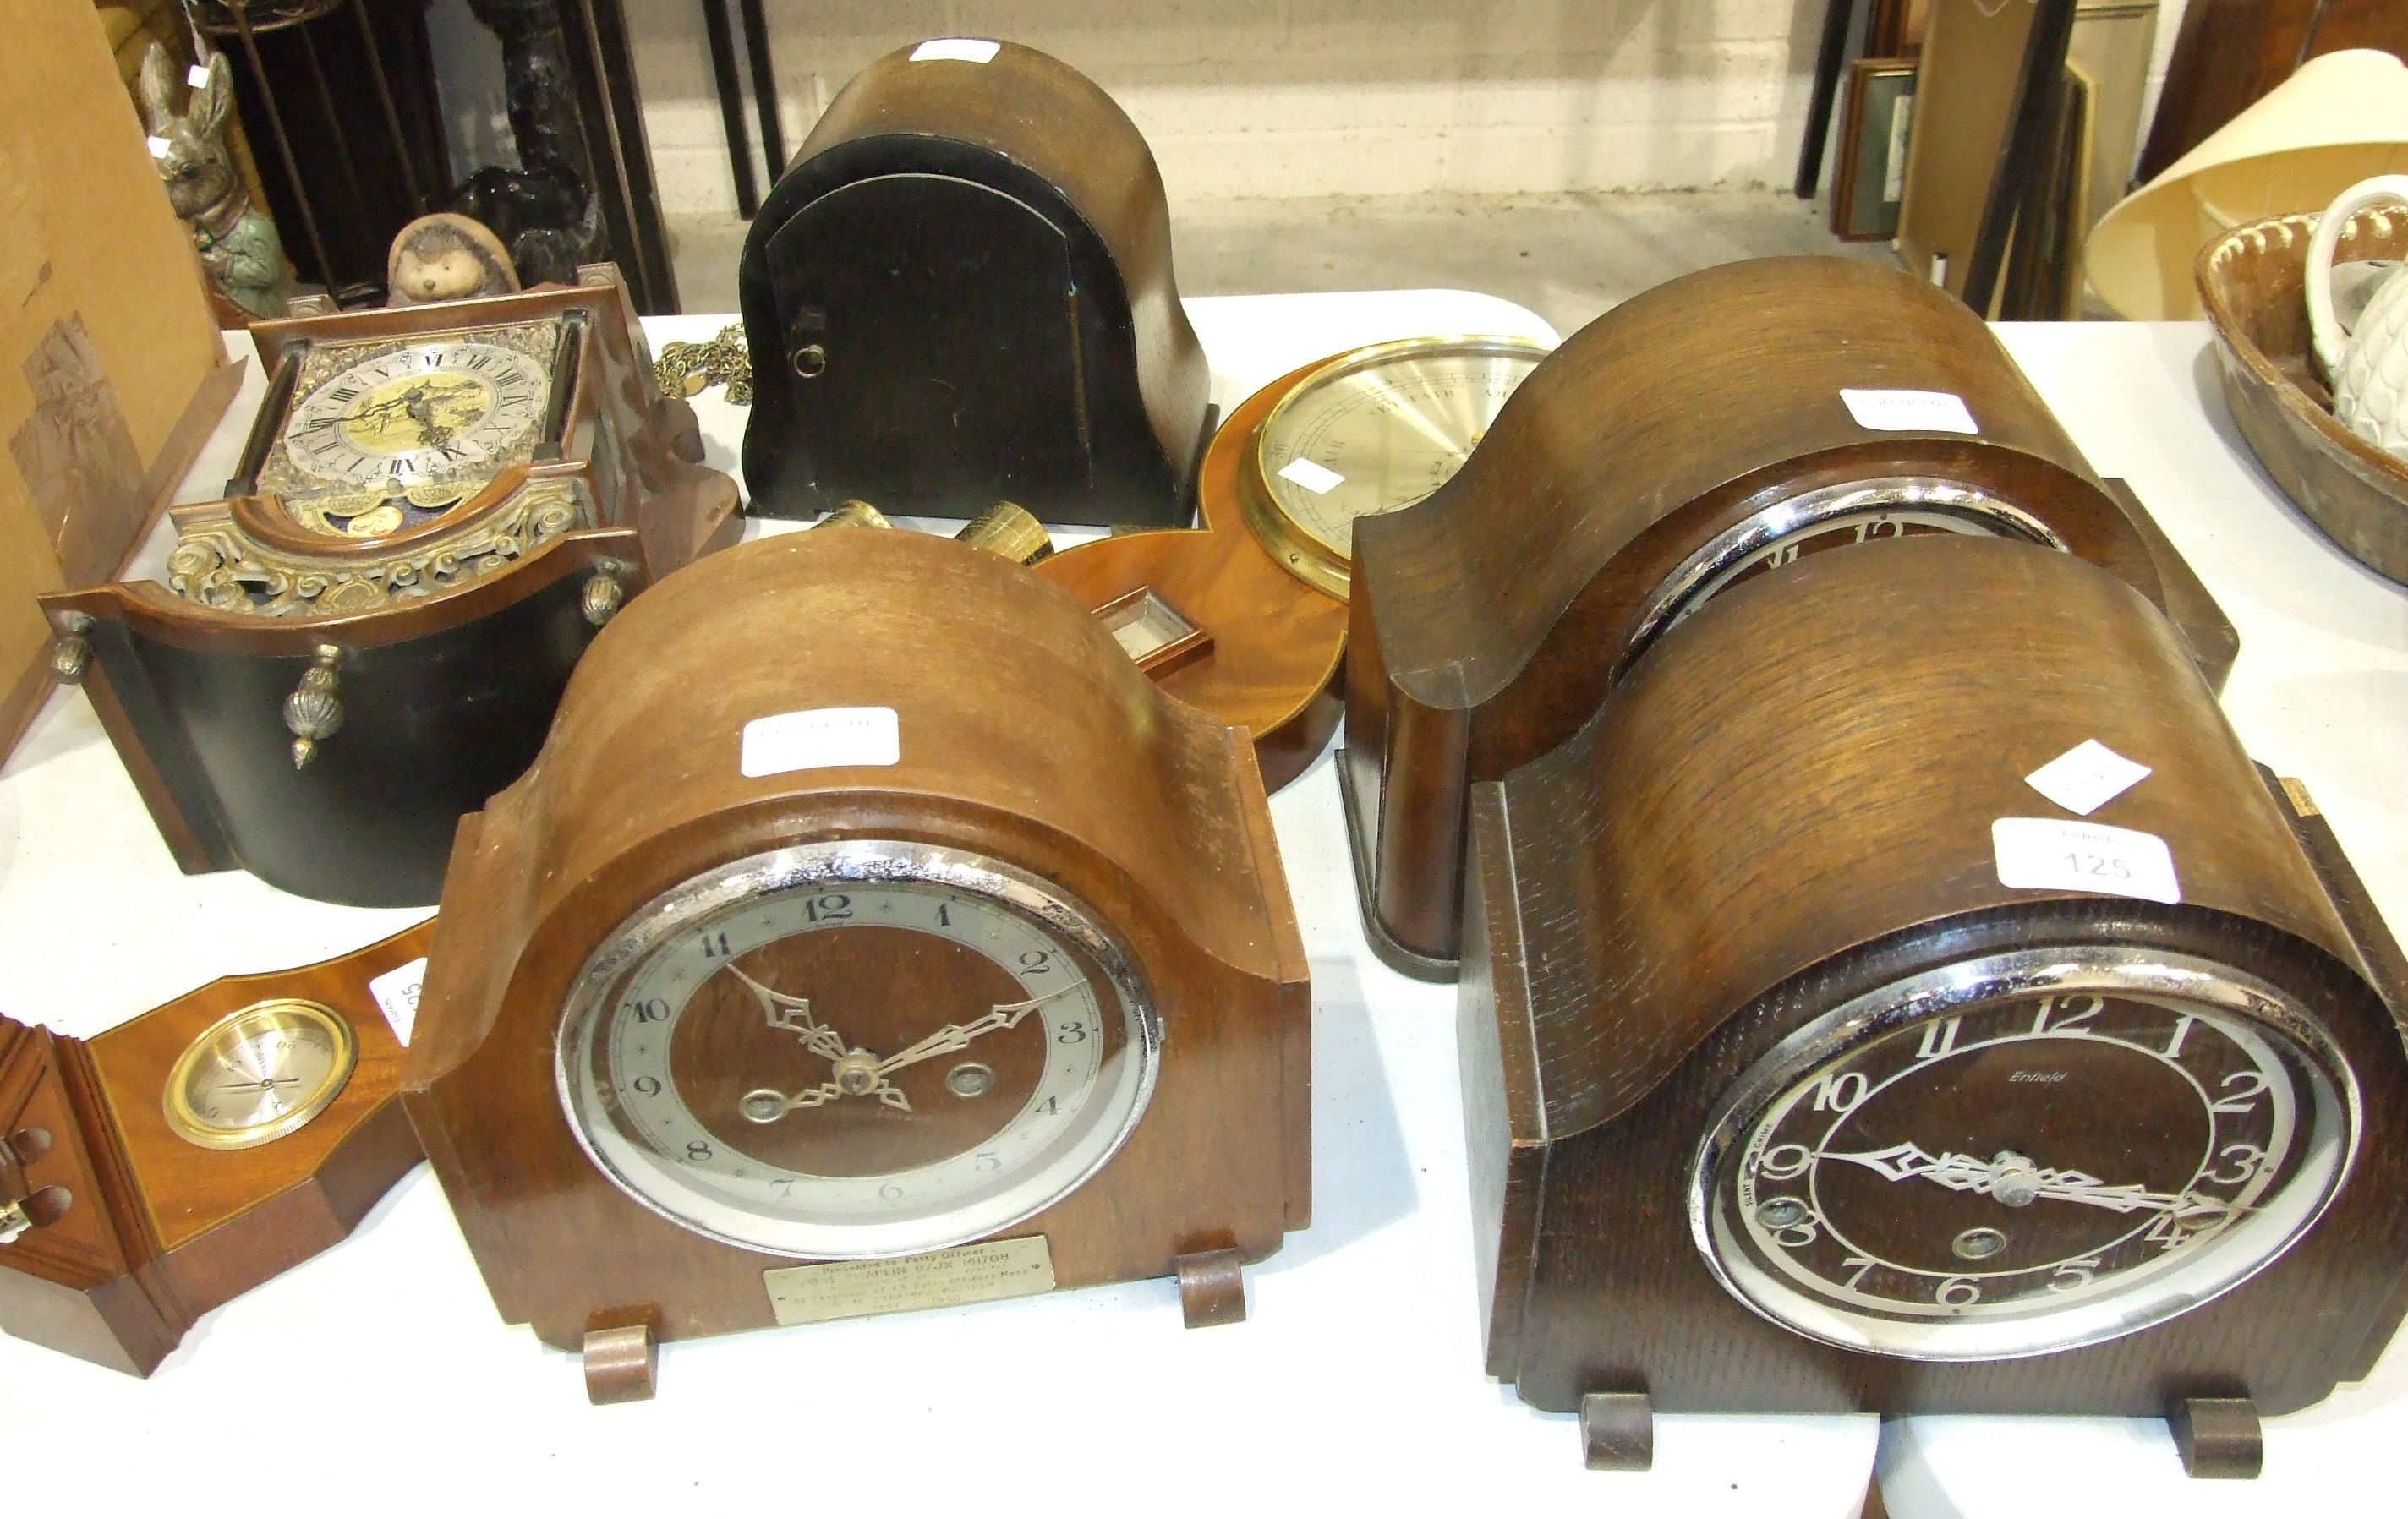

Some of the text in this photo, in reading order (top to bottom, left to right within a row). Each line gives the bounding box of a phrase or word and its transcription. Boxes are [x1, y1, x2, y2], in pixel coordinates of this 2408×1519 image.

[2065, 853, 2131, 879] 125
[802, 894, 853, 923] 12
[933, 903, 953, 926] 1
[700, 933, 735, 957] 11
[1018, 951, 1051, 975] 2
[632, 998, 671, 1023] 10
[2029, 994, 2105, 1038] 12
[1058, 1021, 1086, 1044] 3
[1916, 1017, 1961, 1060] 11
[2165, 1014, 2197, 1058] 1
[635, 1076, 662, 1098] 9
[2008, 1071, 2068, 1083] Enfield
[1812, 1071, 1868, 1113] 10
[2211, 1072, 2272, 1114] 2
[1034, 1096, 1059, 1117] 4
[1754, 1122, 1773, 1149] CHIME
[687, 1141, 714, 1163] 8
[974, 1151, 1002, 1174] 5
[1759, 1144, 1814, 1181] 9
[2202, 1145, 2268, 1183] 3
[770, 1178, 796, 1199] 7
[878, 1183, 905, 1207] 6
[1743, 1183, 1754, 1207] SILENT
[2144, 1212, 2192, 1249] 4
[906, 1254, 936, 1265] Petty
[942, 1248, 985, 1259] Officer
[1841, 1256, 1880, 1292] 7
[2048, 1257, 2101, 1292] 5
[1936, 1276, 1981, 1309] 6
